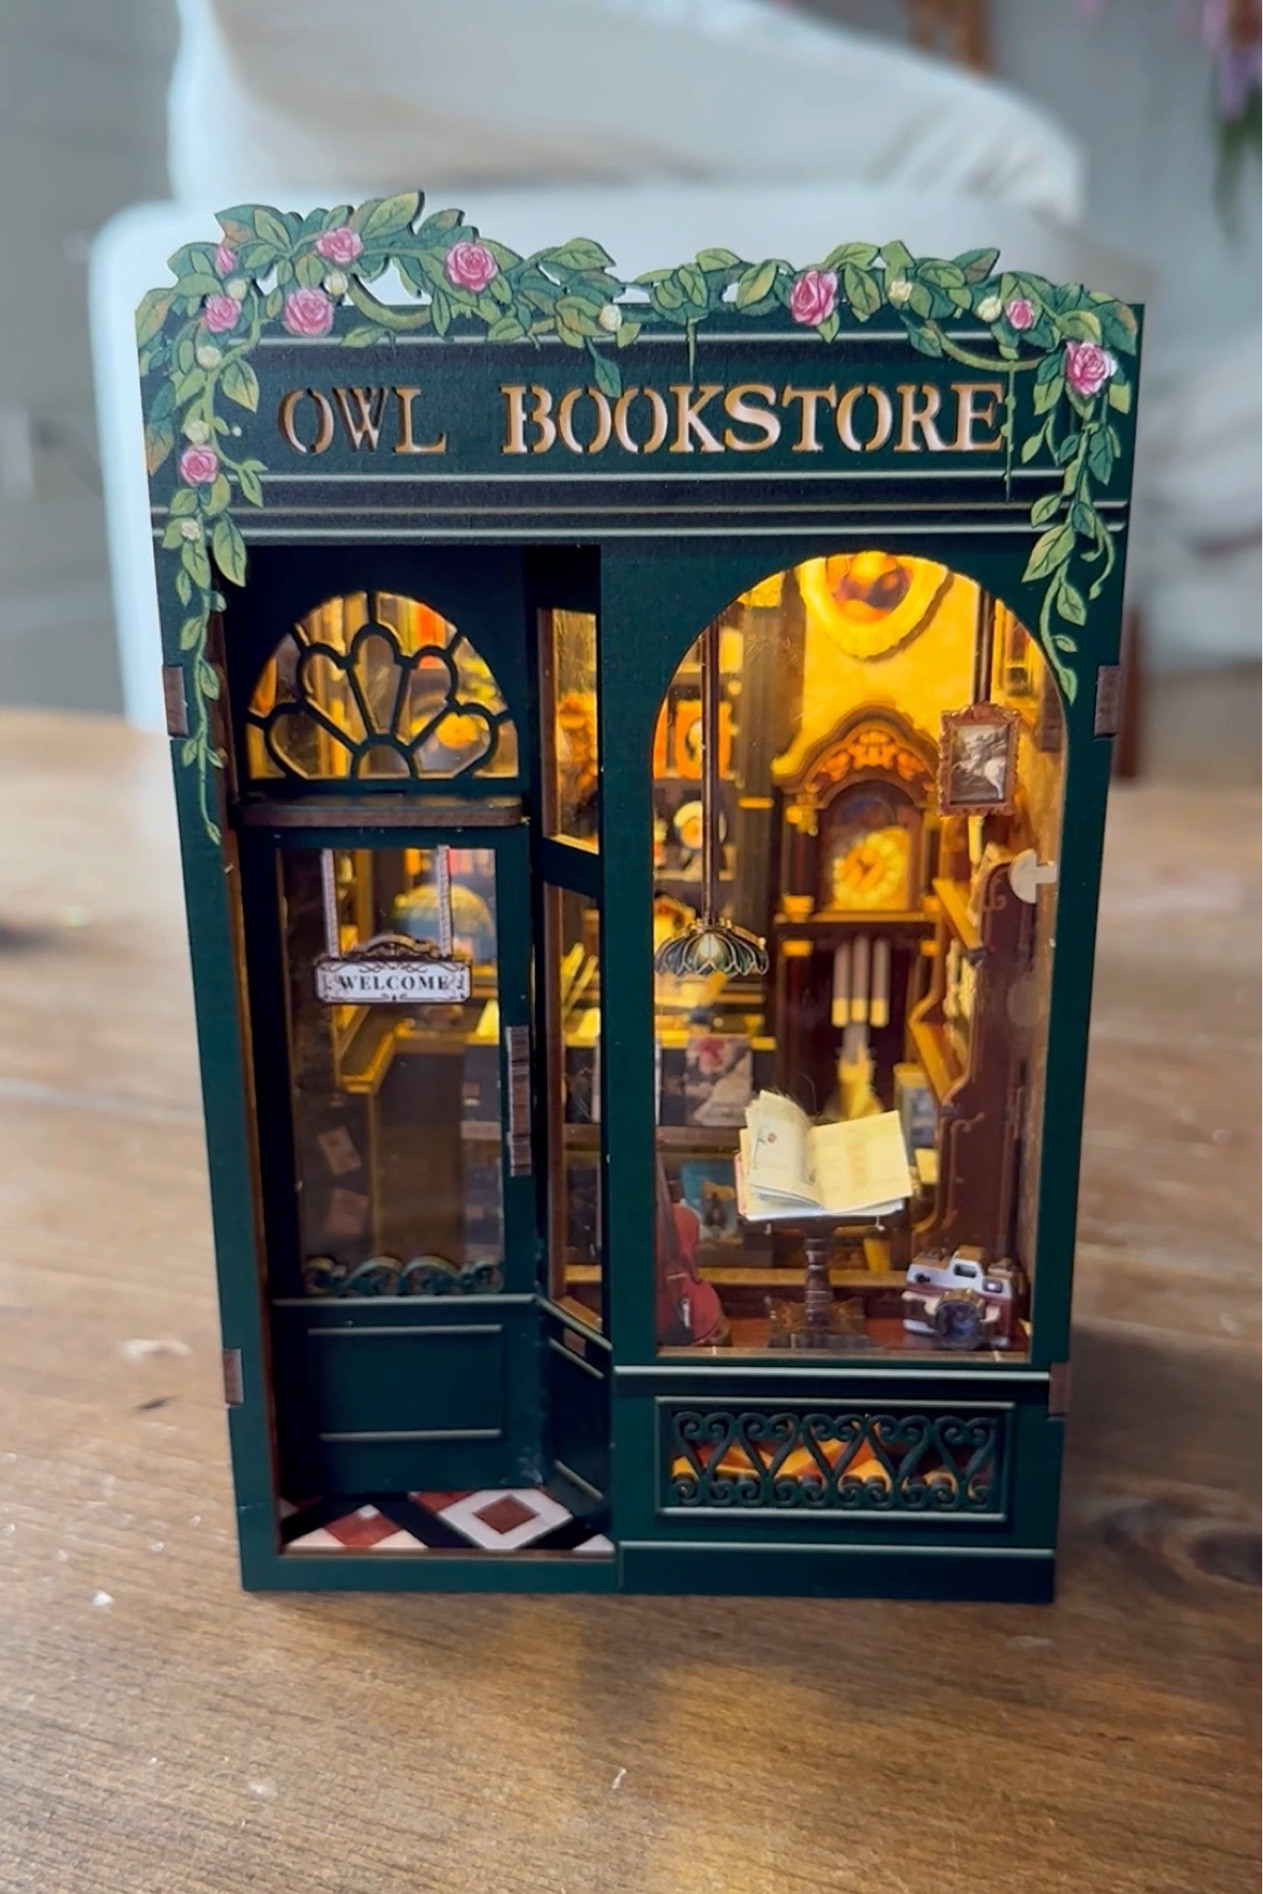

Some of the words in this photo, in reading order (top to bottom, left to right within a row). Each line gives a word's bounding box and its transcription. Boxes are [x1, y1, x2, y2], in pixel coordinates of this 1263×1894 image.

[277, 386, 447, 454] OWL
[500, 384, 1003, 453] BOOKSTORE
[338, 974, 450, 991] WELCOME
